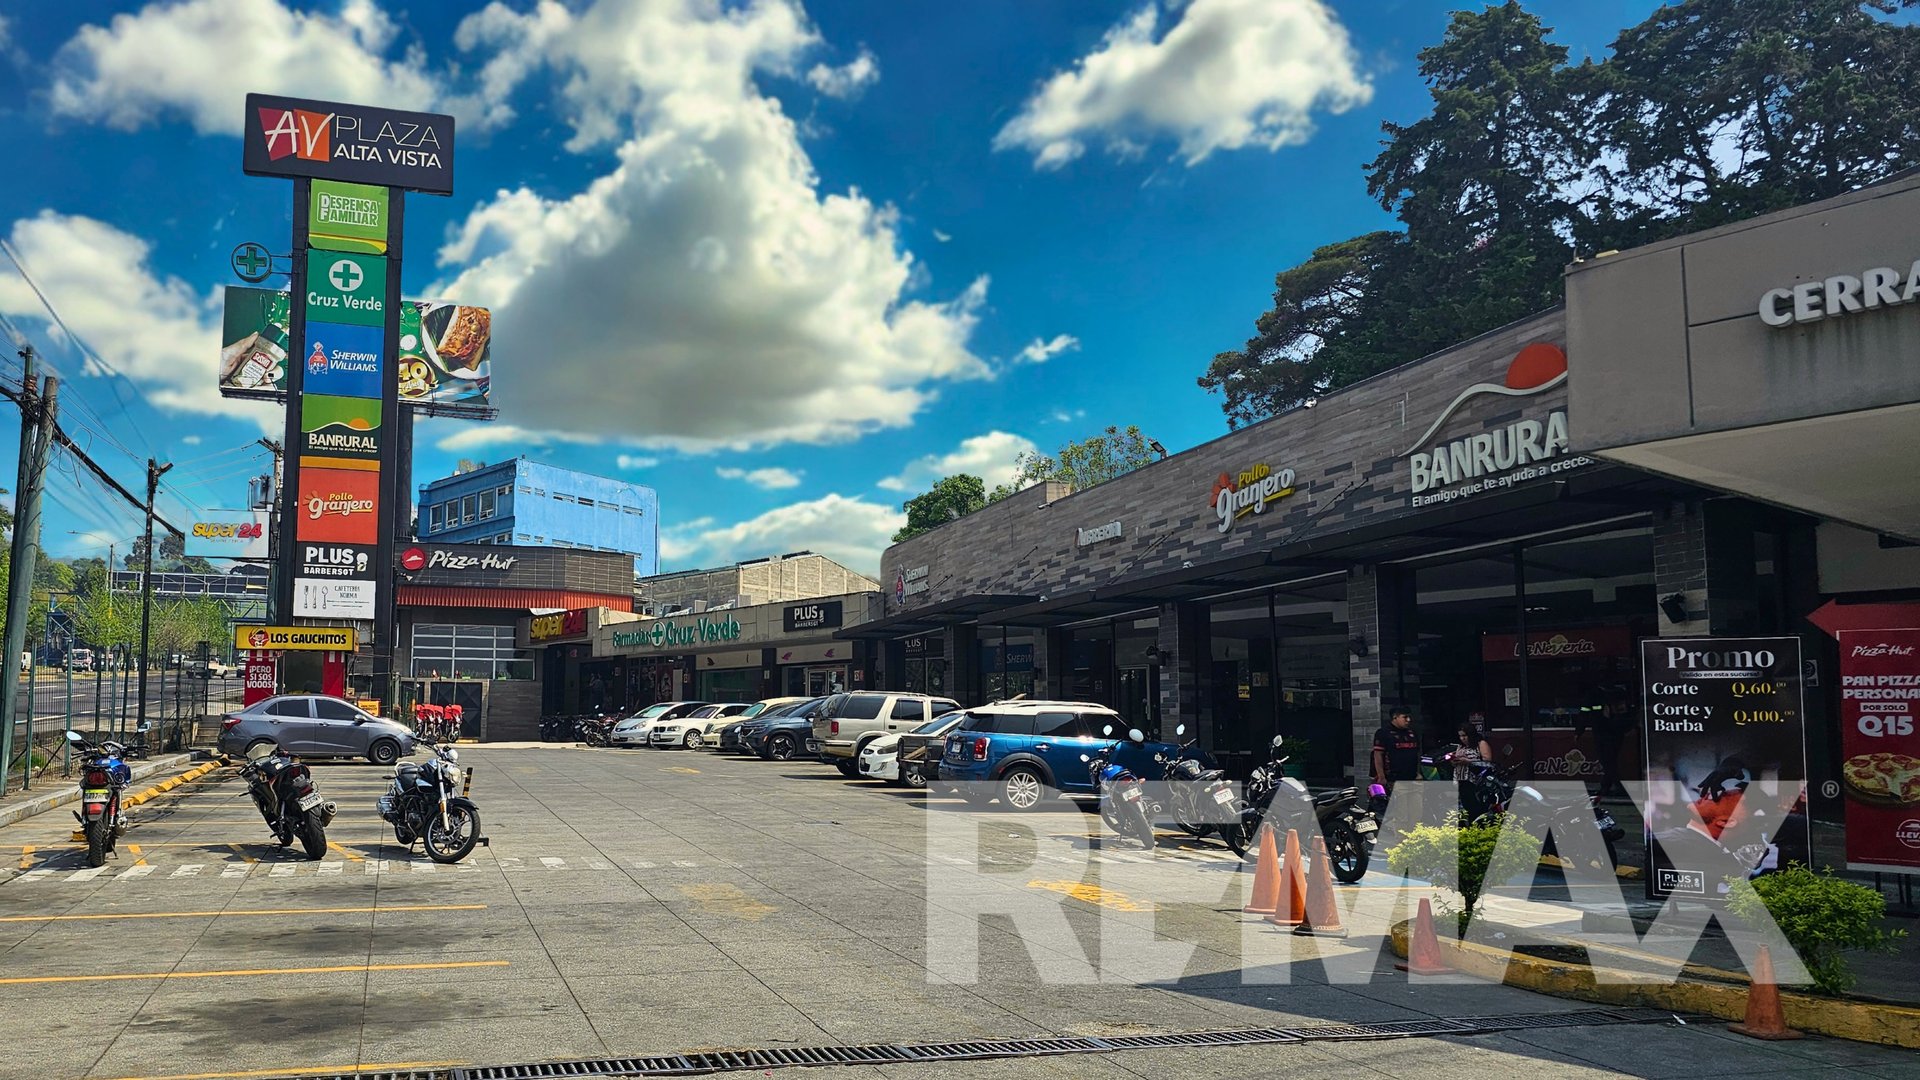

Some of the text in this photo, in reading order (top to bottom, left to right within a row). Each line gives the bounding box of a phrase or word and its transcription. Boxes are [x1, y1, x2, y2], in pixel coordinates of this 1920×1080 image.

[265, 111, 335, 157] AV
[336, 115, 441, 150] PLAZA
[334, 143, 442, 169] ALTA VISTA
[319, 194, 379, 213] DESPENSA
[319, 208, 378, 226] FAMILIAR
[308, 291, 382, 311] Cruz Verde
[331, 349, 377, 362] SHERWIN
[309, 433, 378, 449] BANRURAL
[1239, 463, 1270, 488] Pollo
[1413, 496, 1424, 507] El
[1424, 490, 1458, 505] amigo
[1460, 483, 1482, 498] que
[1484, 478, 1497, 490] te
[1499, 467, 1536, 488] ayuda
[1539, 466, 1549, 477] a
[329, 493, 353, 501] Pollo
[1217, 468, 1295, 533] granjero
[308, 497, 373, 519] granjero
[192, 522, 262, 539] super 24
[305, 546, 354, 564] PLUS
[428, 550, 519, 570] Pizza Hut
[303, 567, 354, 576] BARBERSOT
[794, 605, 818, 620] PLUS
[666, 620, 696, 646] Cruz
[697, 613, 740, 642] Verde
[270, 633, 346, 644] LOS GAUCHITOS
[1667, 647, 1775, 669] Promo
[1851, 644, 1915, 657] Pizza Hut
[258, 673, 272, 681] SOS
[1842, 675, 1874, 686] PAN
[1652, 682, 1699, 695] Corte
[1843, 688, 1920, 700] PERSONA
[1653, 703, 1714, 719] Corte y
[1654, 719, 1704, 732] Barba
[1857, 715, 1914, 737] Q15
[1664, 873, 1692, 883] PLUS
